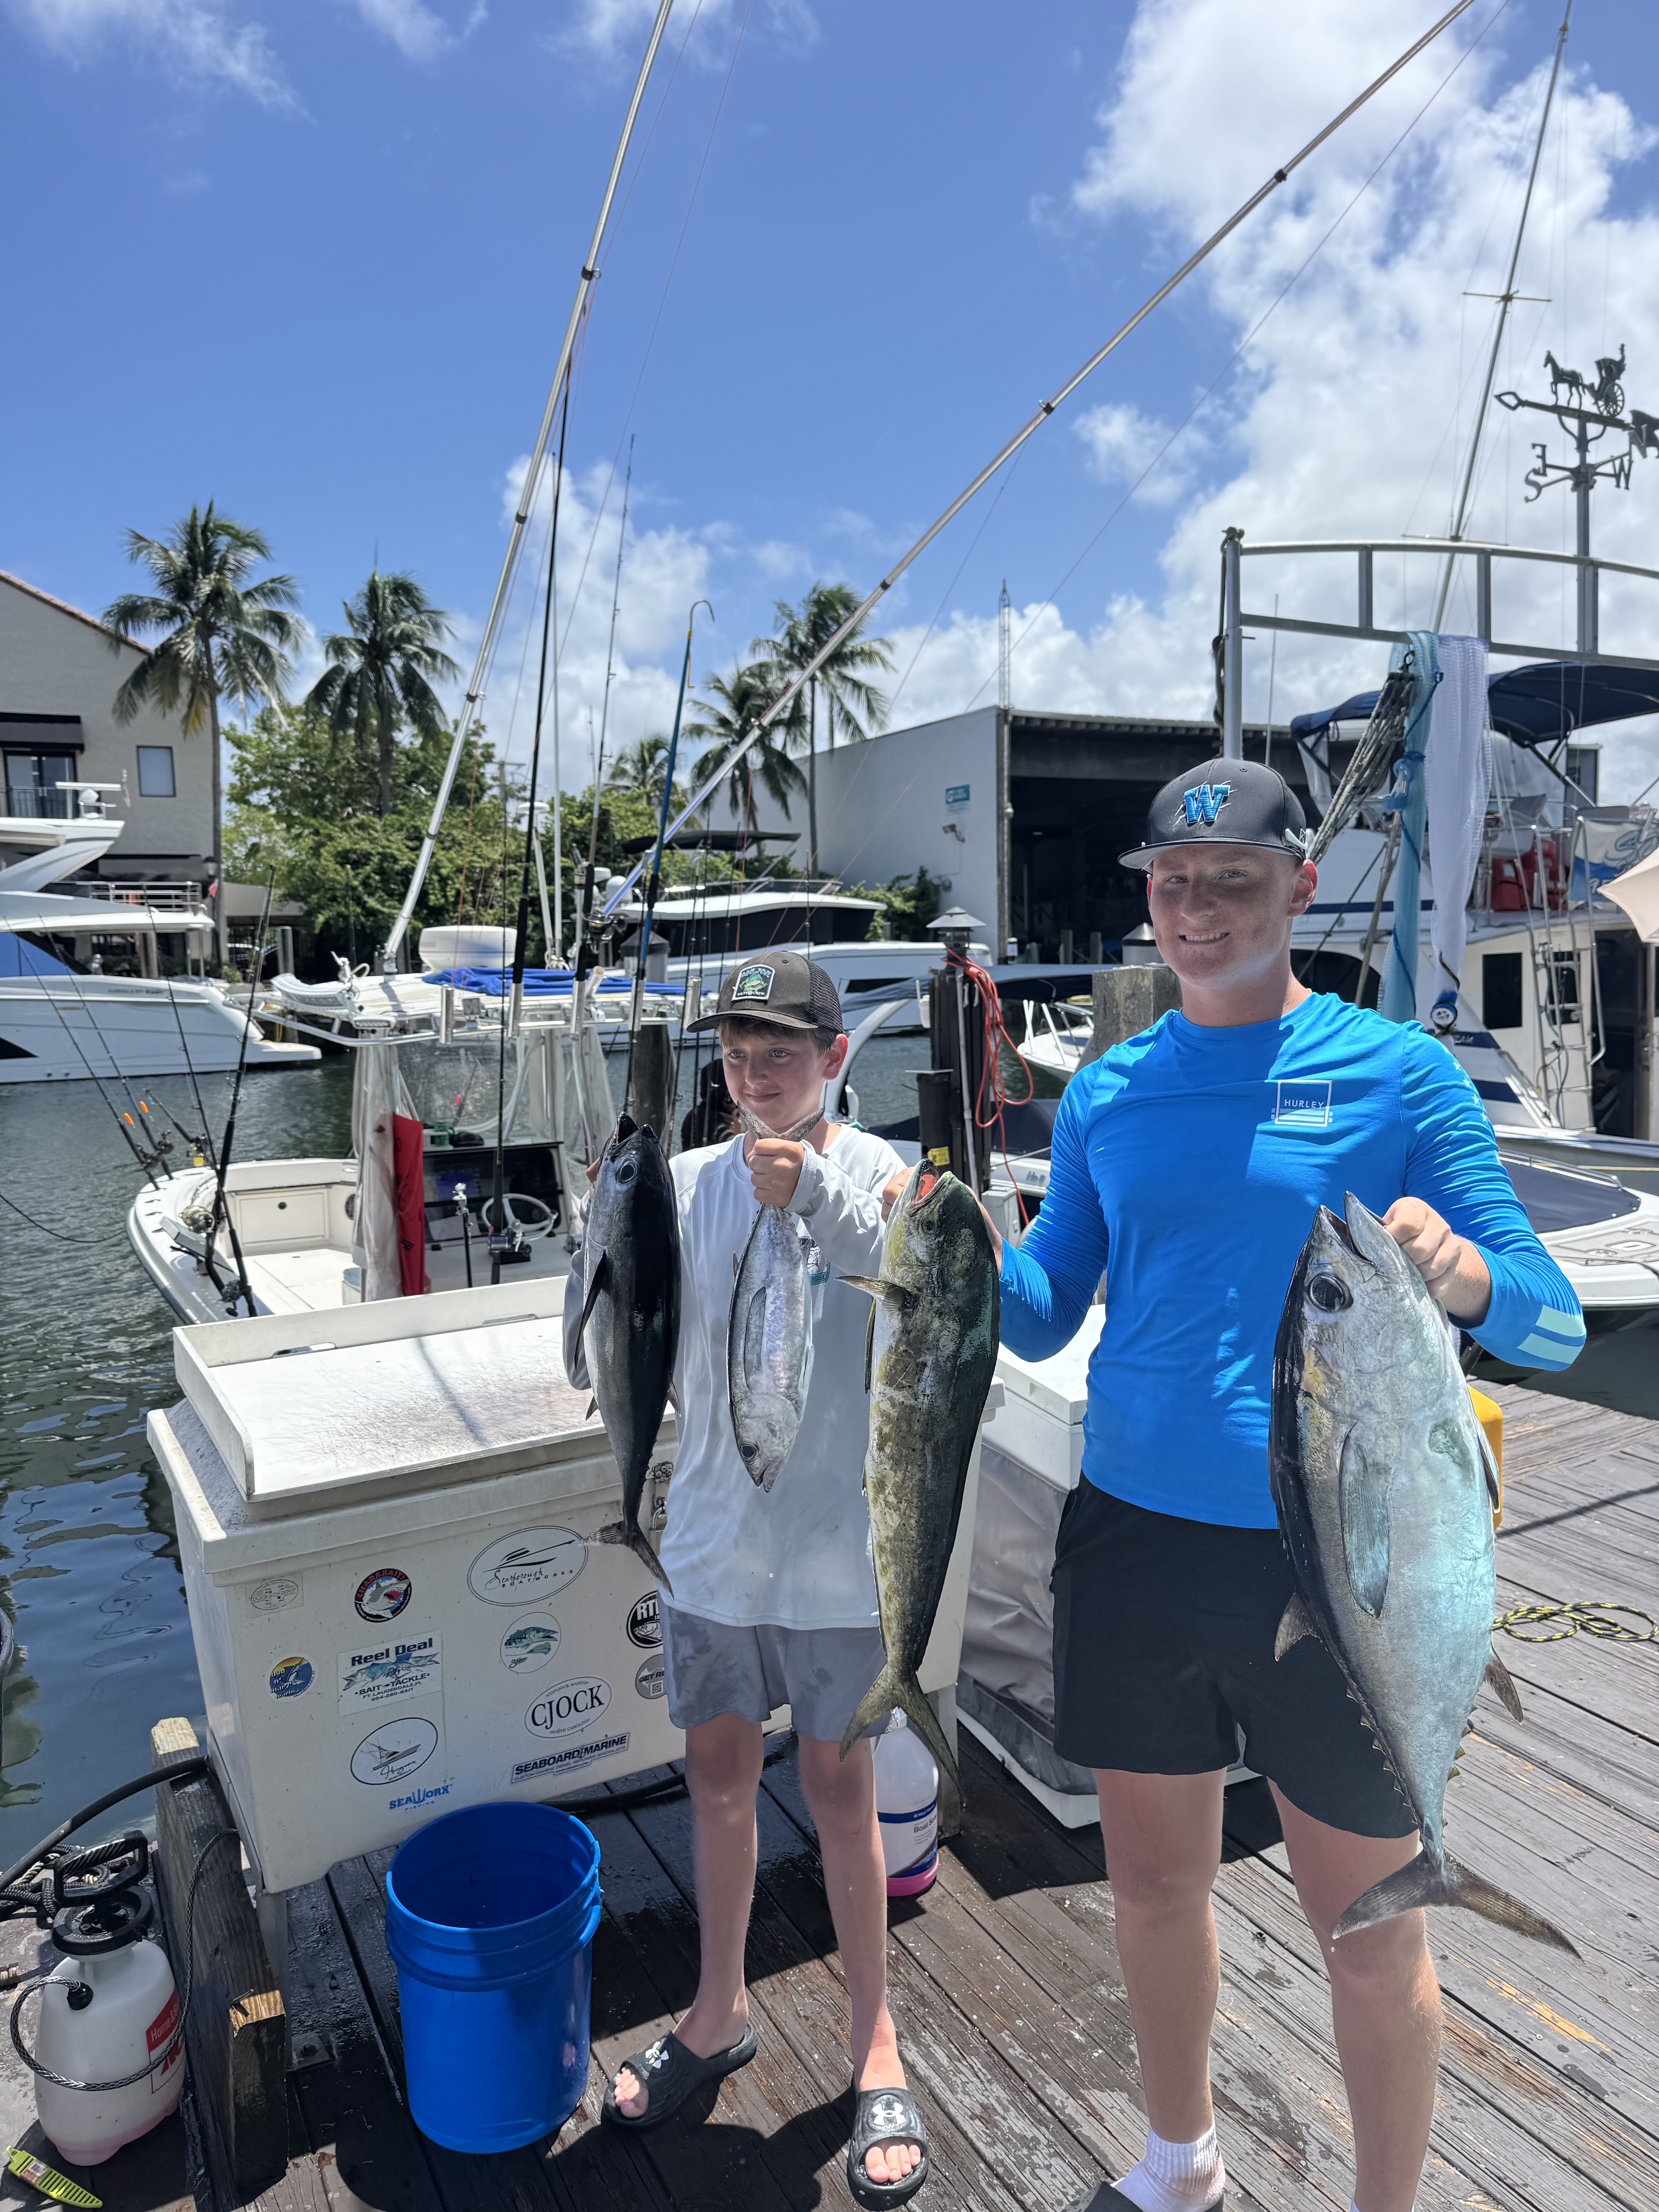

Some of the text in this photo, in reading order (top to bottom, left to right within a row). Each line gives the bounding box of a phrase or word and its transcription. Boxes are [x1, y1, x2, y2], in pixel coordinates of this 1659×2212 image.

[1523, 467, 1542, 503] S
[1184, 785, 1230, 823] W
[1285, 1099, 1324, 1109] HURLEY
[351, 1637, 433, 1666] Reel Deal
[359, 1673, 427, 1695] BAIT TACKLE
[639, 1673, 655, 1682] GET
[531, 1685, 605, 1729] CJOCK
[515, 1735, 627, 1775] SEABOARD MARINE
[389, 1784, 450, 1810] SEAWORX
[405, 1800, 434, 1811] FISHING
[914, 1822, 928, 1832] Boat
